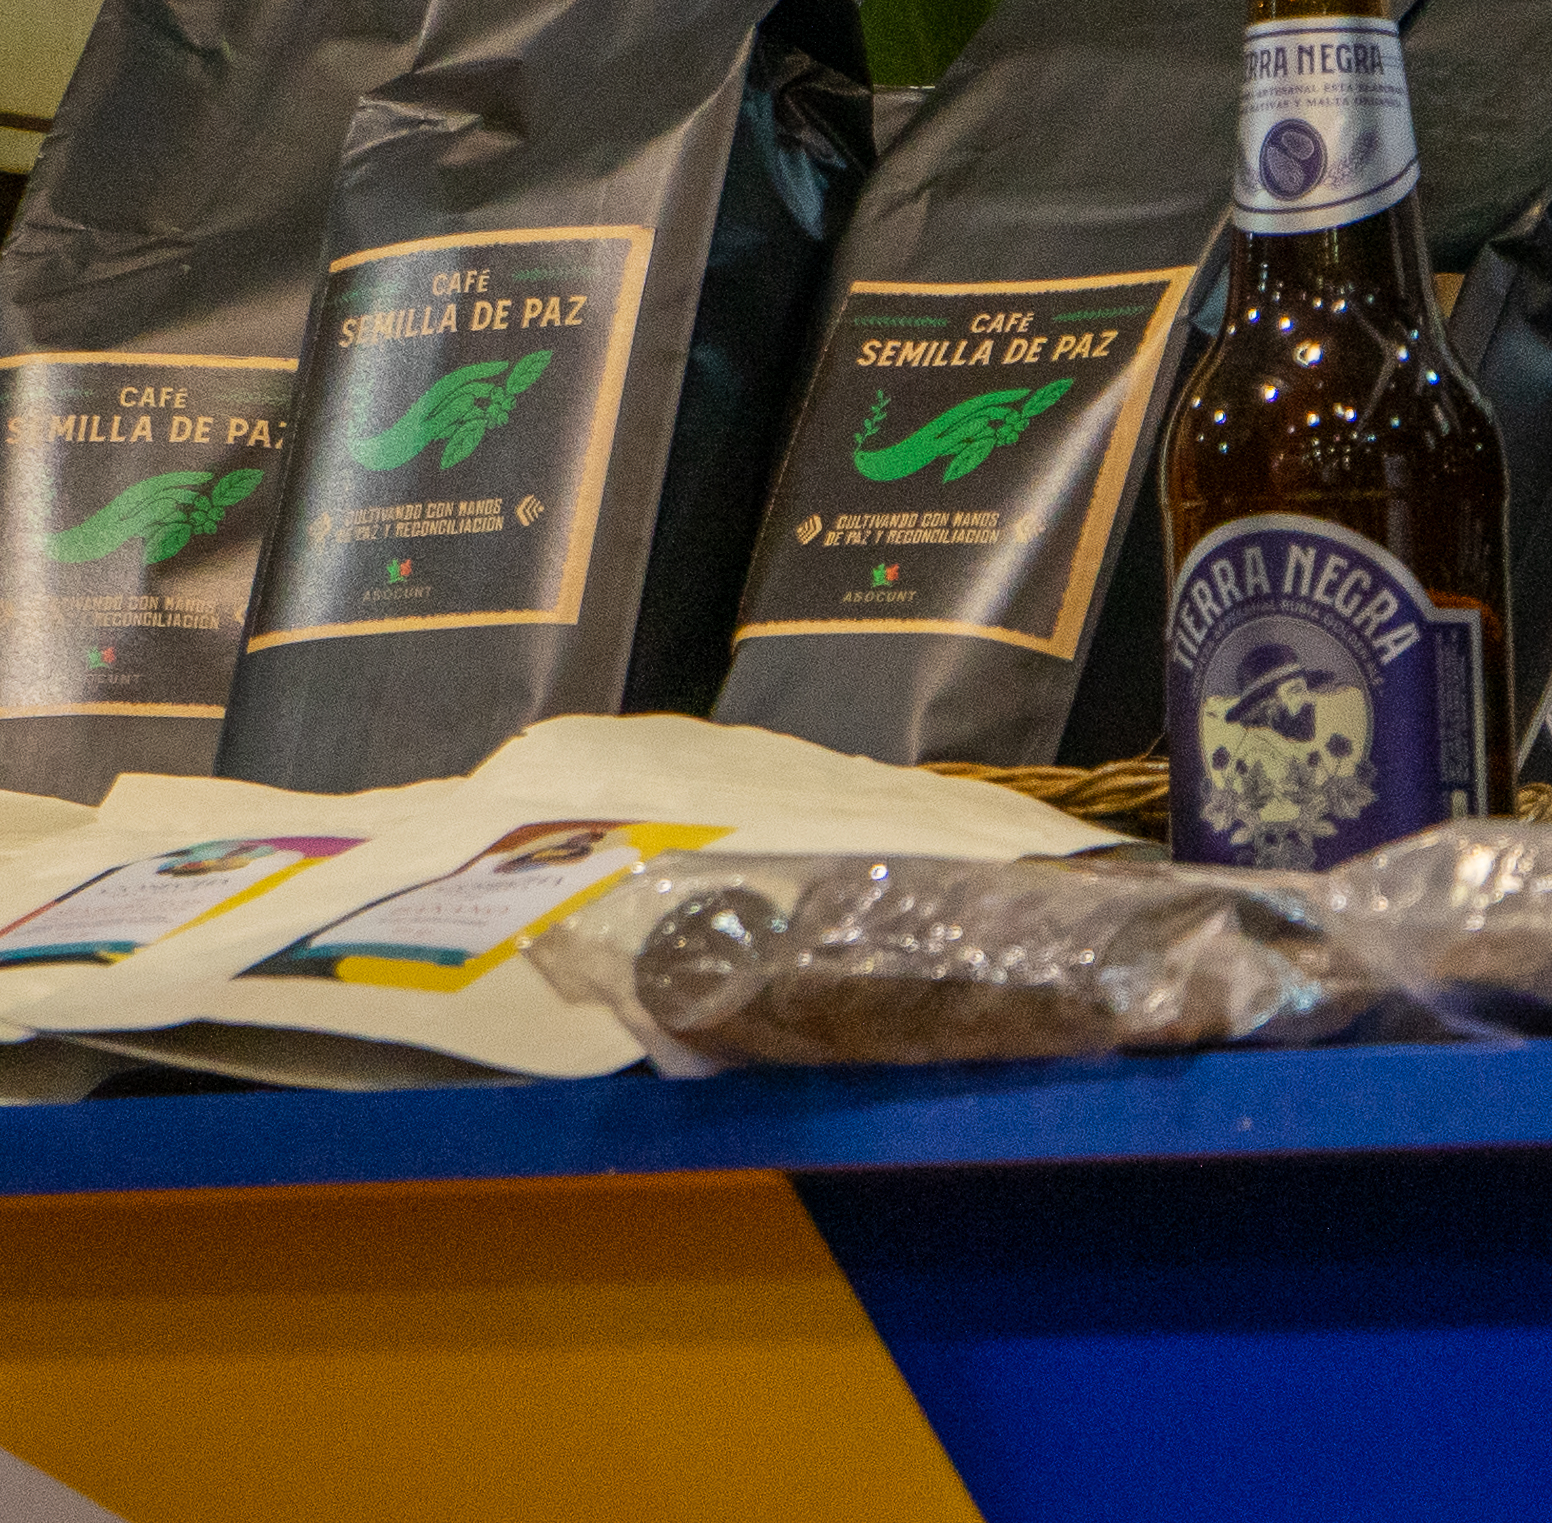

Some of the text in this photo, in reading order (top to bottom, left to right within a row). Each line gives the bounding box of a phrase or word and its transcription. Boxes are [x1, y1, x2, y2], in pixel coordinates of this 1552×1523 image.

[1297, 42, 1385, 76] NEGRA
[432, 269, 490, 297] CAFÉ
[339, 295, 587, 348] SEMILLA DE PAZ
[968, 310, 1035, 335] CAFÉ
[856, 328, 1120, 368] SEMILLA DE PAZ
[119, 385, 189, 409] CAFÉ
[168, 415, 214, 444] DE
[426, 500, 454, 517] CON
[457, 498, 504, 517] MANOS
[834, 511, 1001, 530] CULTIVANDO CON MANOS
[822, 530, 842, 547] DE
[844, 530, 871, 546] PAZ
[873, 529, 884, 545] Y
[841, 589, 917, 604] ASOCUNT
[1282, 542, 1423, 668] NEGRA
